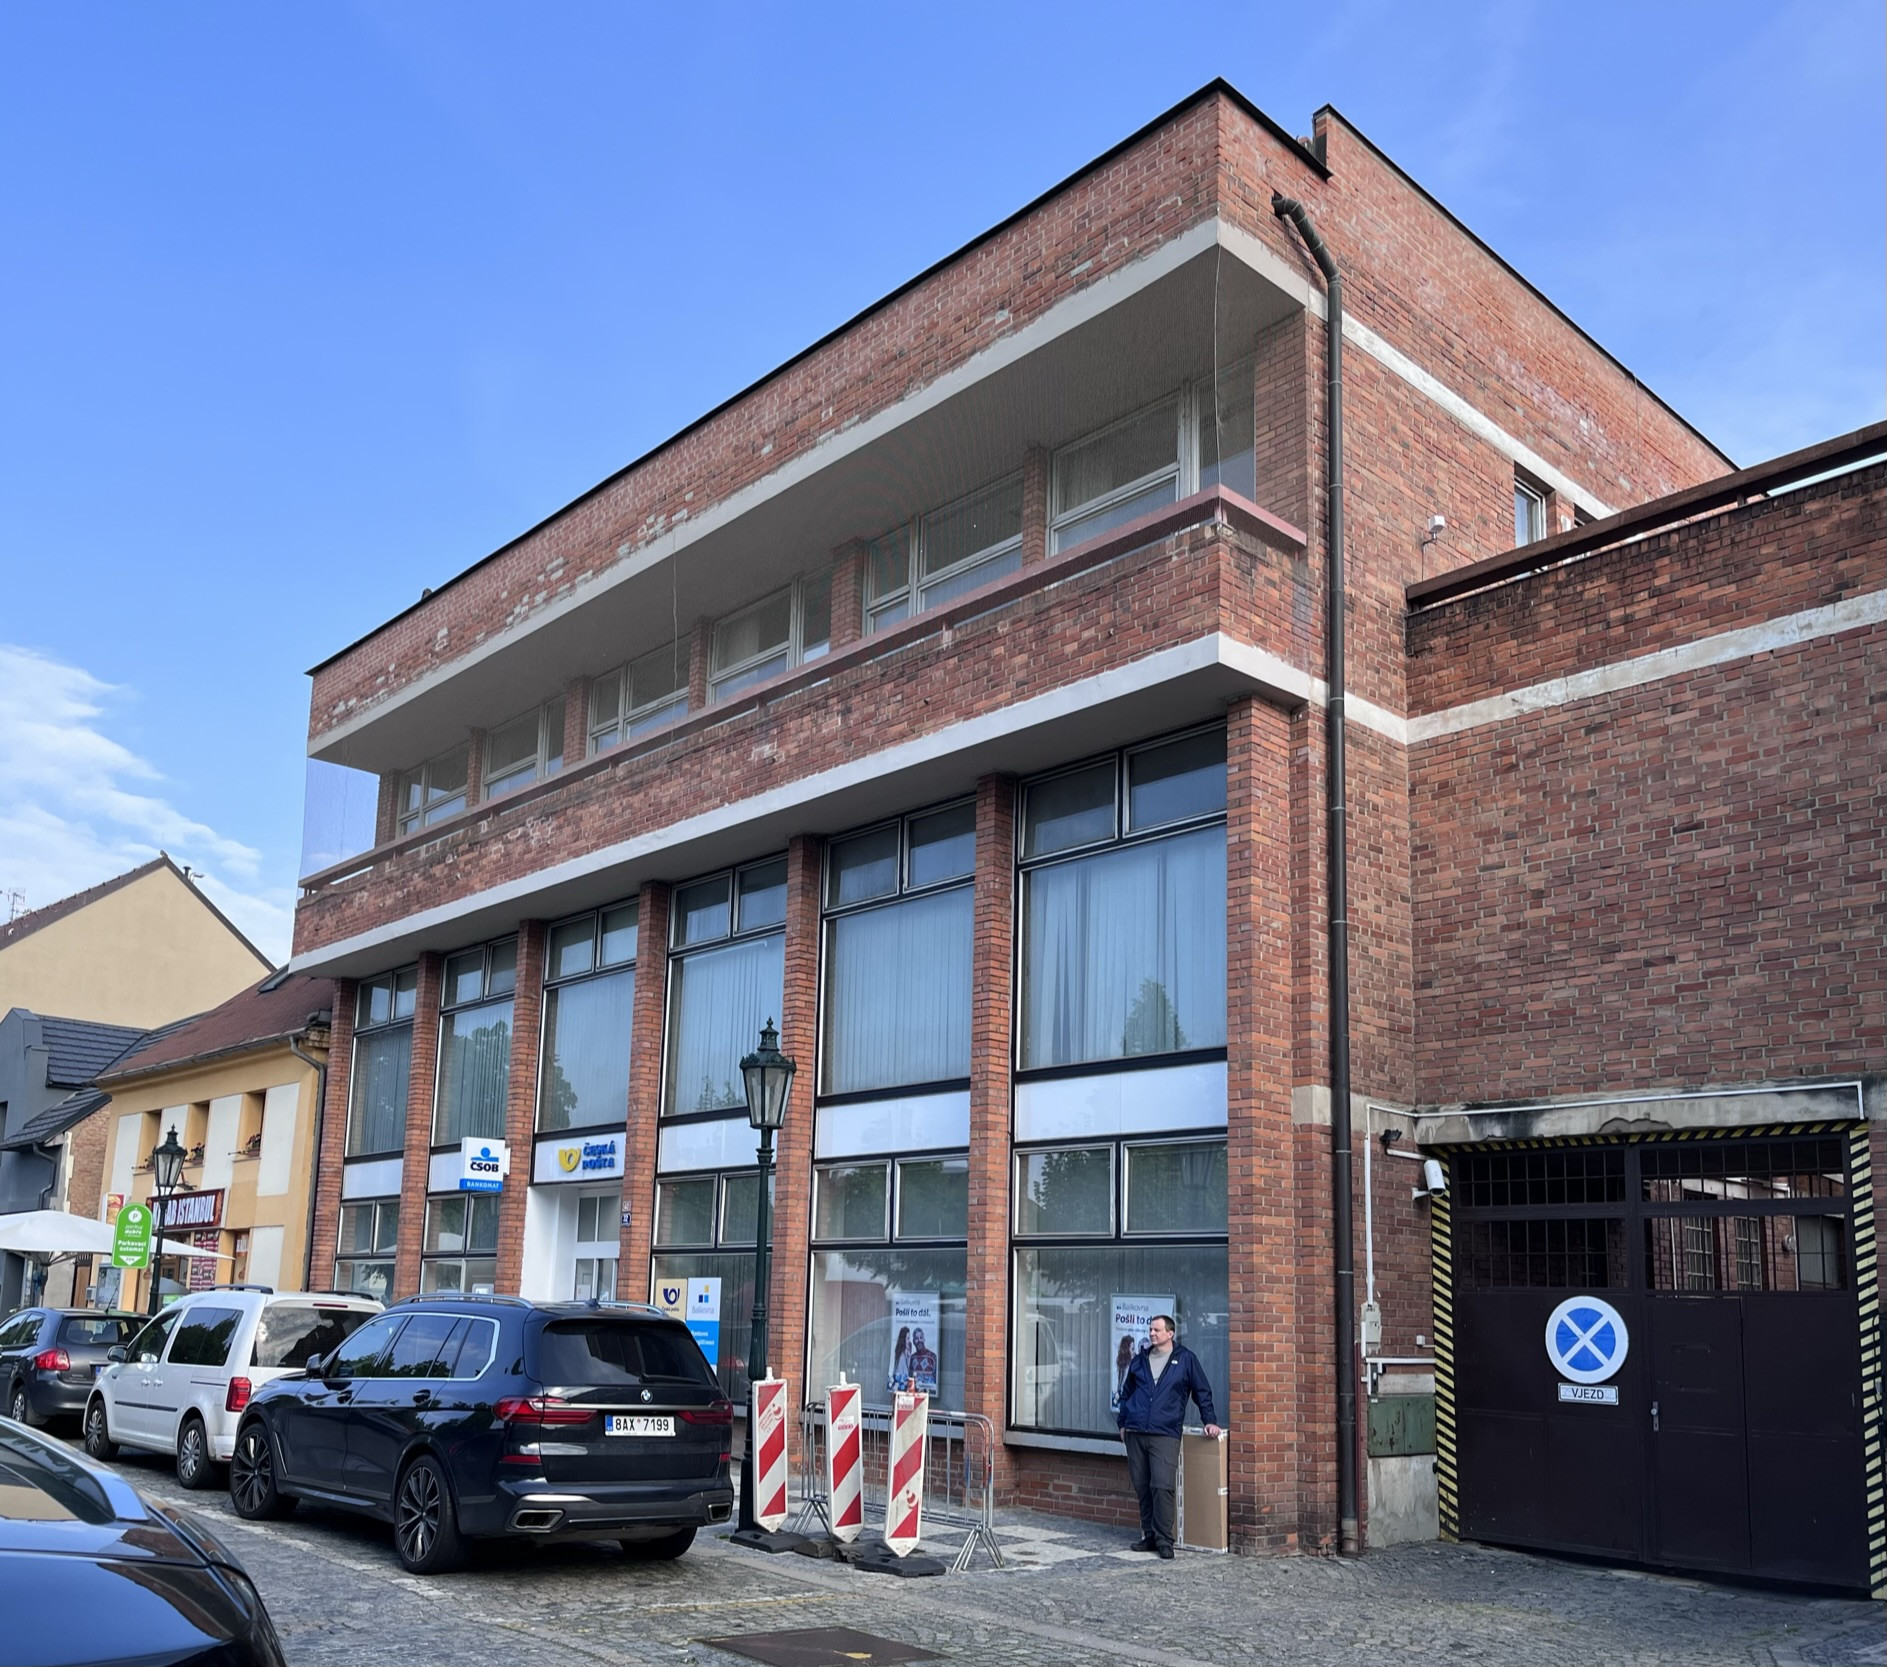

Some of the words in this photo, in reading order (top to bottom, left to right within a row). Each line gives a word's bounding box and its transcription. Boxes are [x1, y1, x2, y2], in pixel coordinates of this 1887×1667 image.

[470, 1161, 499, 1172] ČSOB
[466, 1181, 499, 1189] BANKOMAT
[152, 1200, 177, 1226] KAB
[176, 1194, 215, 1225] ISTANBUL
[896, 1308, 909, 1316] Pošli
[911, 1308, 917, 1316] to
[1115, 1313, 1135, 1323] Pošli
[1136, 1315, 1146, 1325] to
[1571, 1388, 1605, 1399] VJEZD
[615, 1418, 635, 1431] 8AX
[643, 1418, 670, 1431] 7199
